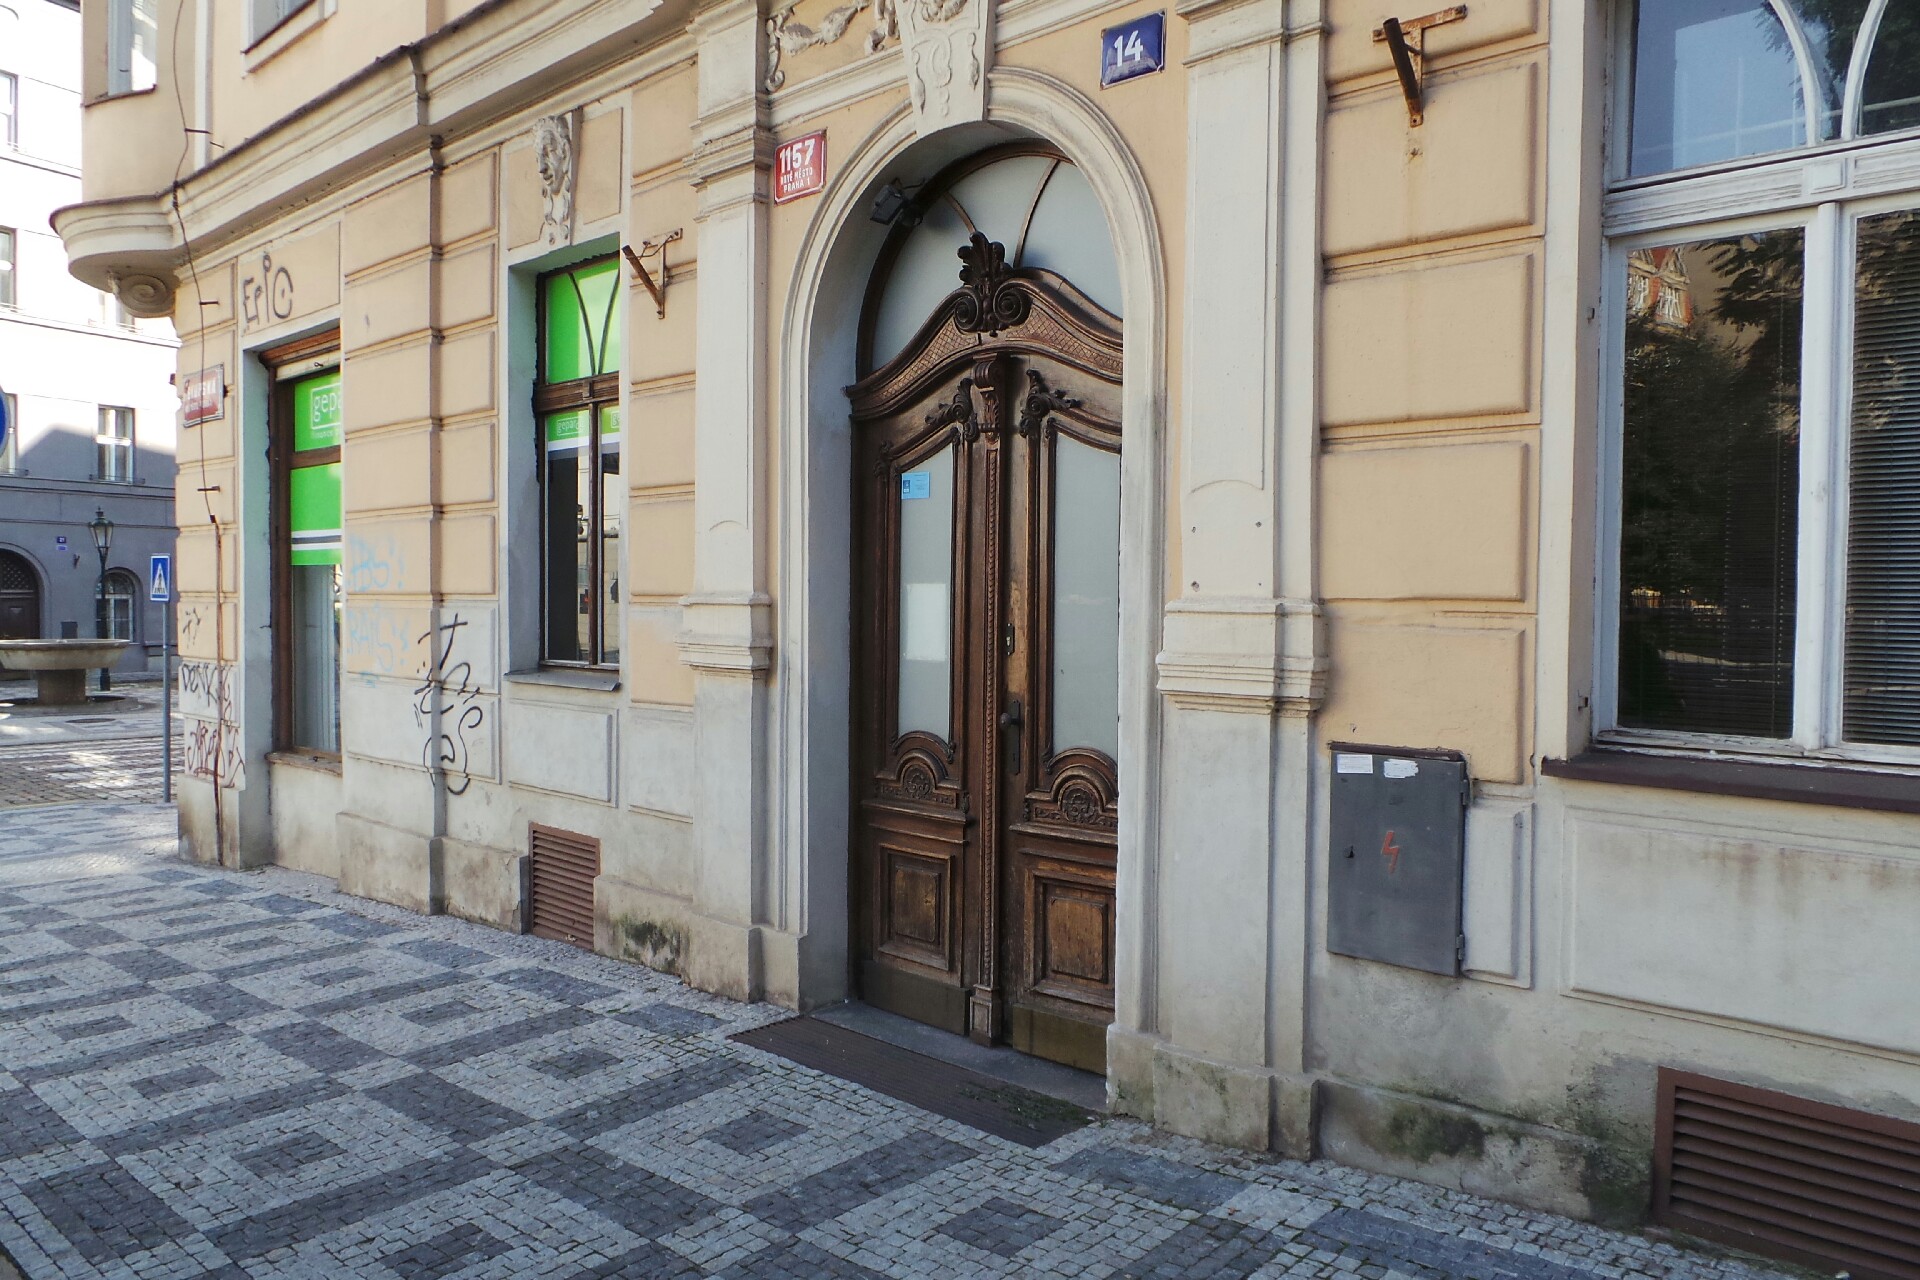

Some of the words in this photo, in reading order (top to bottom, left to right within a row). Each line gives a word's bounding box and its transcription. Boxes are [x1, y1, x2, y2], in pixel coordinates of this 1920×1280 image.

[1113, 29, 1144, 67] 14
[780, 138, 815, 174] 1157
[783, 179, 805, 194] PRAHA
[806, 177, 810, 186] 1
